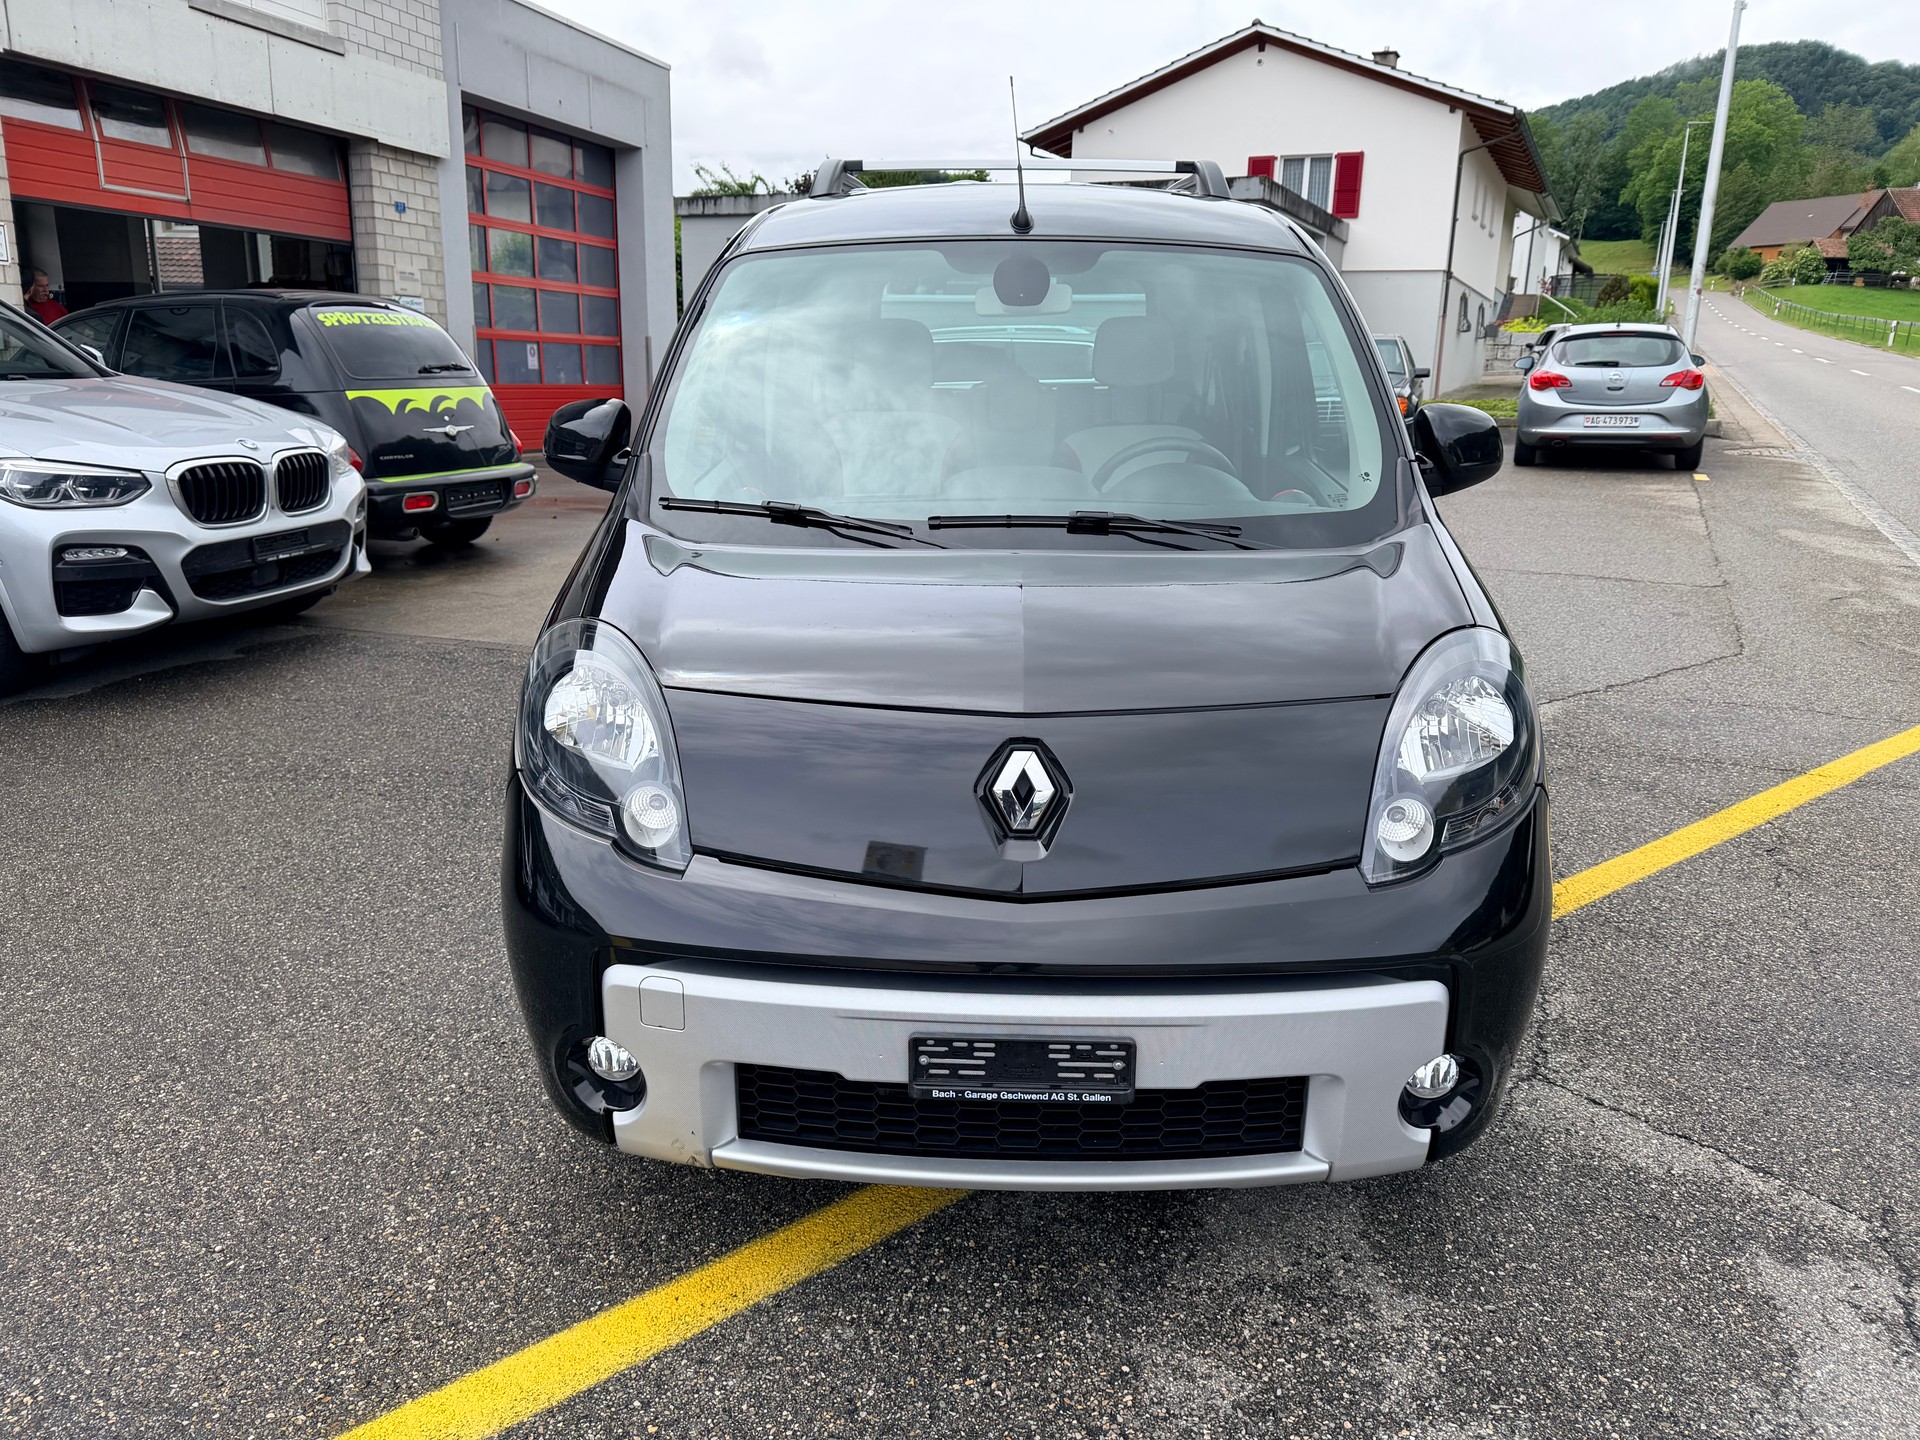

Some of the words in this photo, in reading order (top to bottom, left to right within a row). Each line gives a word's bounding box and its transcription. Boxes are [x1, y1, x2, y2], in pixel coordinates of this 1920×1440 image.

[932, 1089, 956, 1098] Bach
[964, 1090, 998, 1101] Garage
[1000, 1091, 1049, 1100] Gschwend
[1050, 1092, 1065, 1101] AG
[1067, 1093, 1080, 1101] St.
[1082, 1093, 1112, 1102] Gallen
